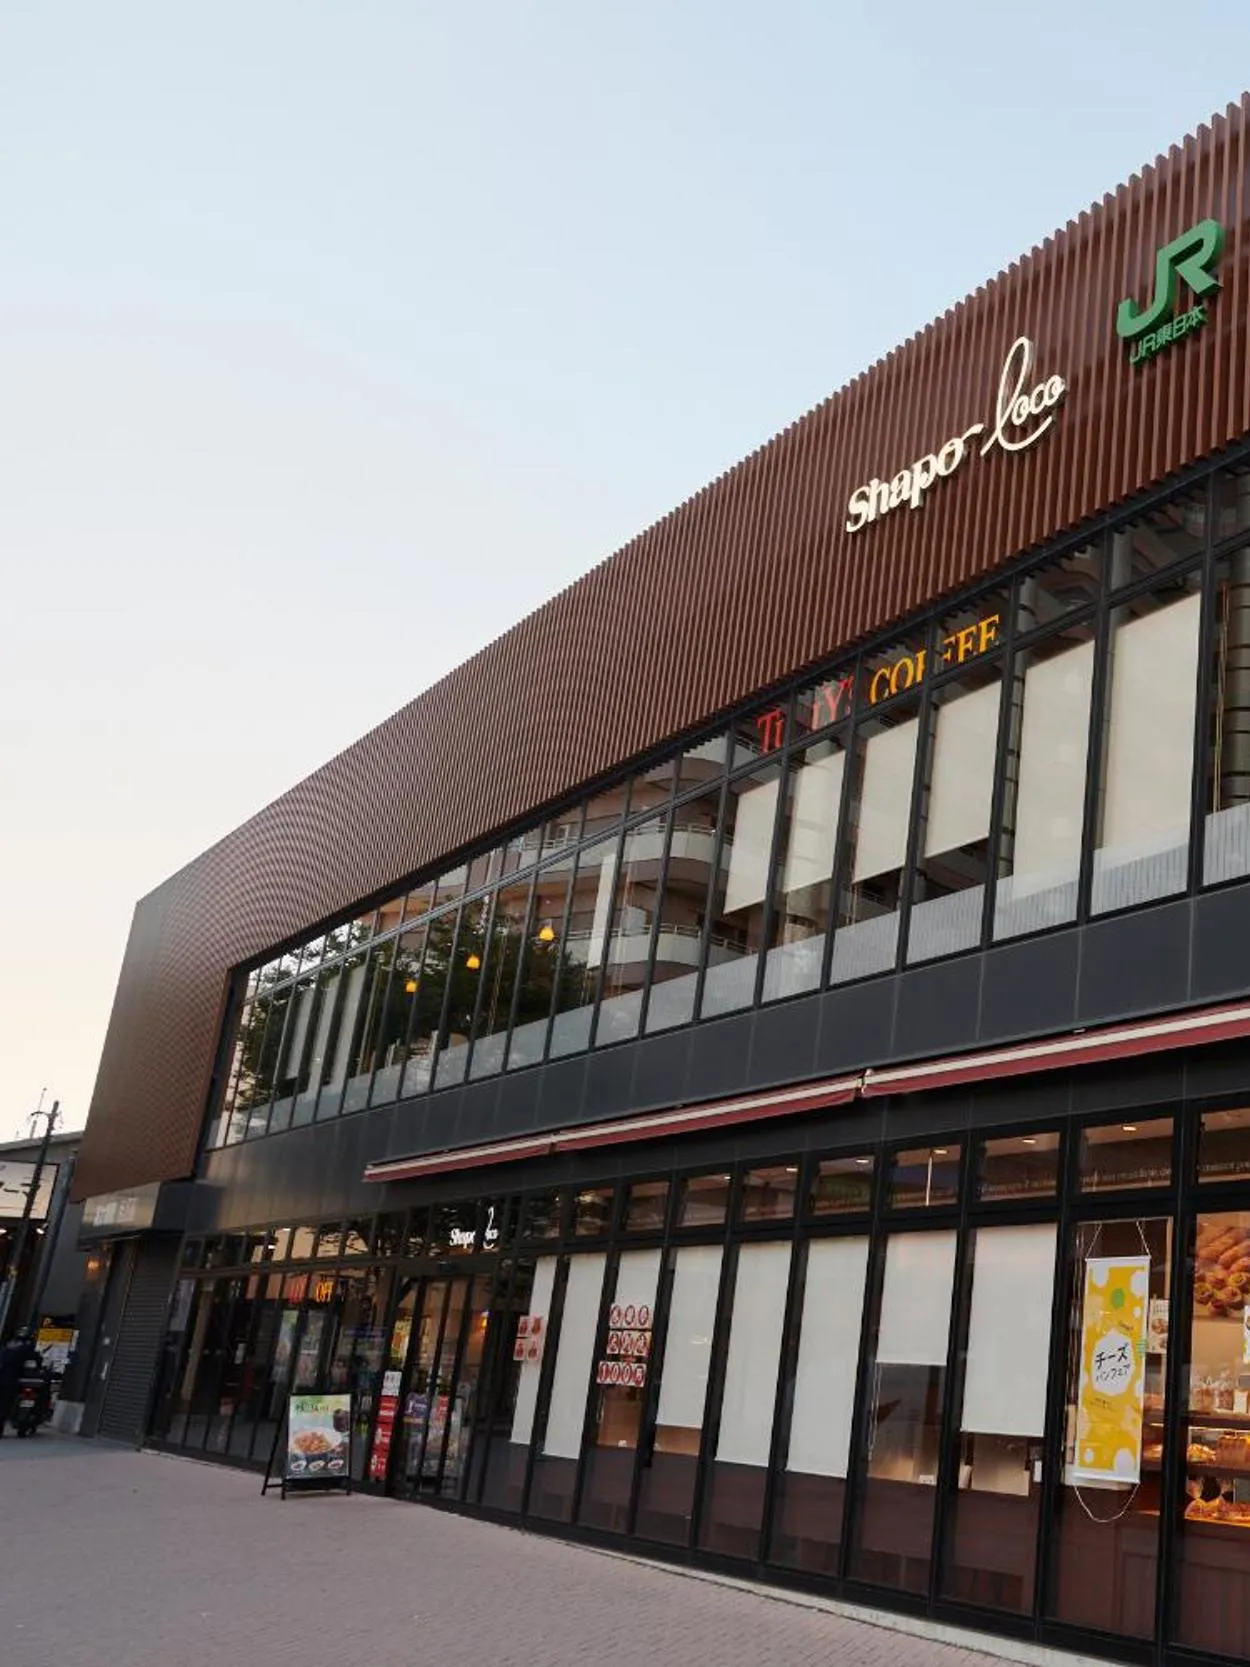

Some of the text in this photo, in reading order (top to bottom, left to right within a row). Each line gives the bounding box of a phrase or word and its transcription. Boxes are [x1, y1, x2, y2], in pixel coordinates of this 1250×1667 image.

[1116, 217, 1224, 338] JR
[1129, 305, 1205, 365] JR東日本
[1096, 1342, 1129, 1370] チーズ
